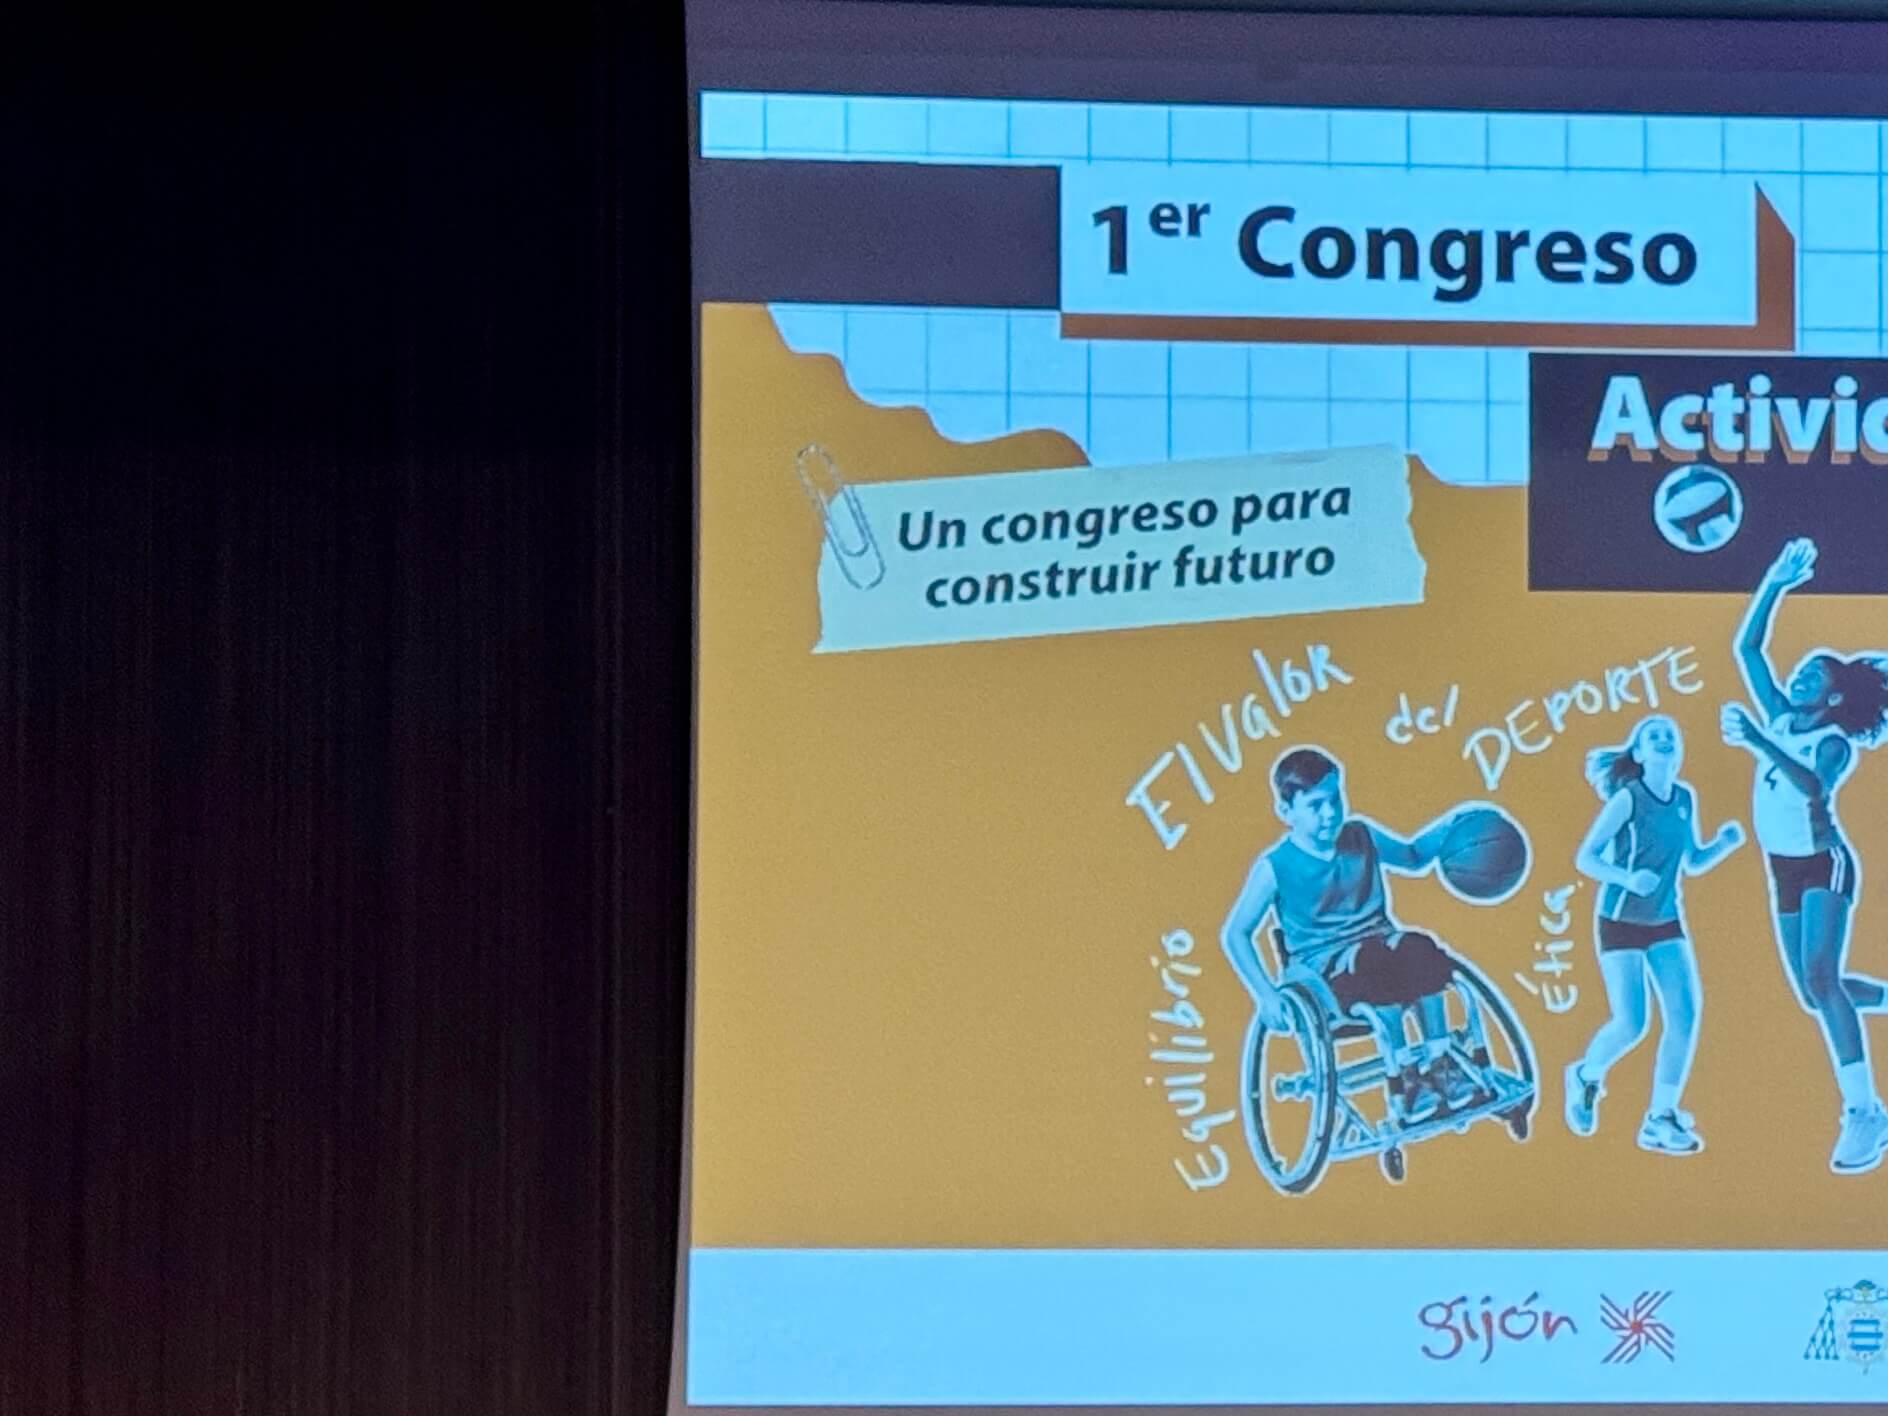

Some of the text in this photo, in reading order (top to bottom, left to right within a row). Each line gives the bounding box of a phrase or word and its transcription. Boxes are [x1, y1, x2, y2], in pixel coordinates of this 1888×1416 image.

[1092, 202, 1698, 303] 1er Congreso
[898, 486, 1352, 553] Un congreso para
[924, 544, 1336, 608] construir futuro
[1385, 683, 1460, 745] del
[1461, 645, 1706, 791] DEPORTE
[1515, 880, 1585, 1013] Ética
[1144, 928, 1238, 1191] Equilibrio
[1417, 1290, 1580, 1364] gijón
